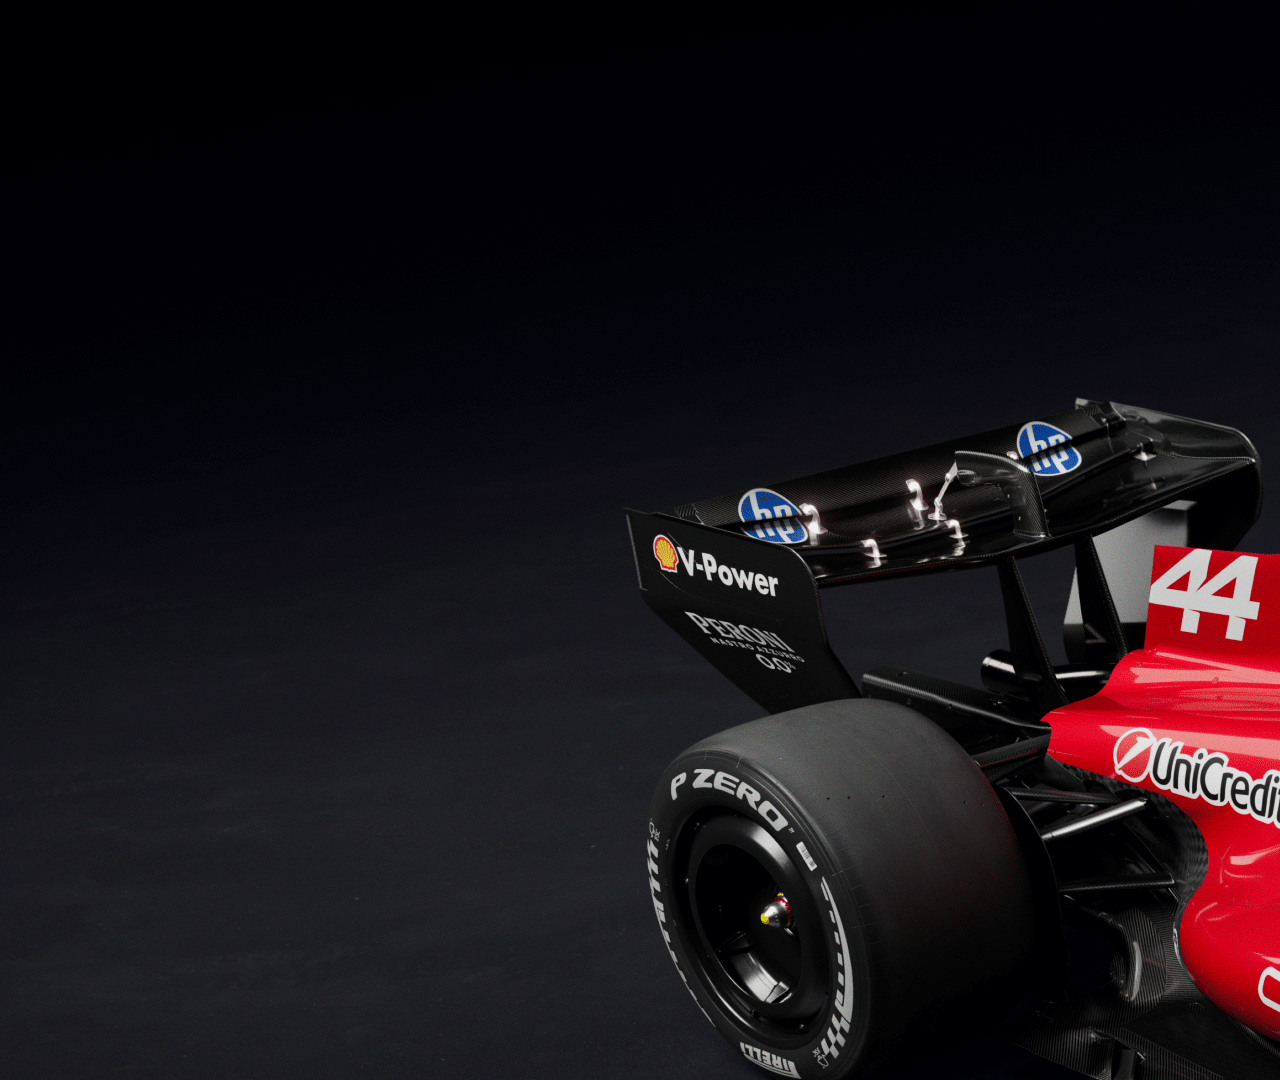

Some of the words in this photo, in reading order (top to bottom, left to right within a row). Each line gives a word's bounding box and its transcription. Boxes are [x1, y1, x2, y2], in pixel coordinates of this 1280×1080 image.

[1020, 421, 1078, 476] hp
[742, 488, 804, 543] hp
[676, 546, 779, 597] V-Power
[1149, 548, 1261, 642] 44
[684, 611, 796, 653] PERONI
[670, 772, 687, 801] P
[692, 768, 789, 832] ZERO
[740, 1041, 802, 1079] PIRELLI
